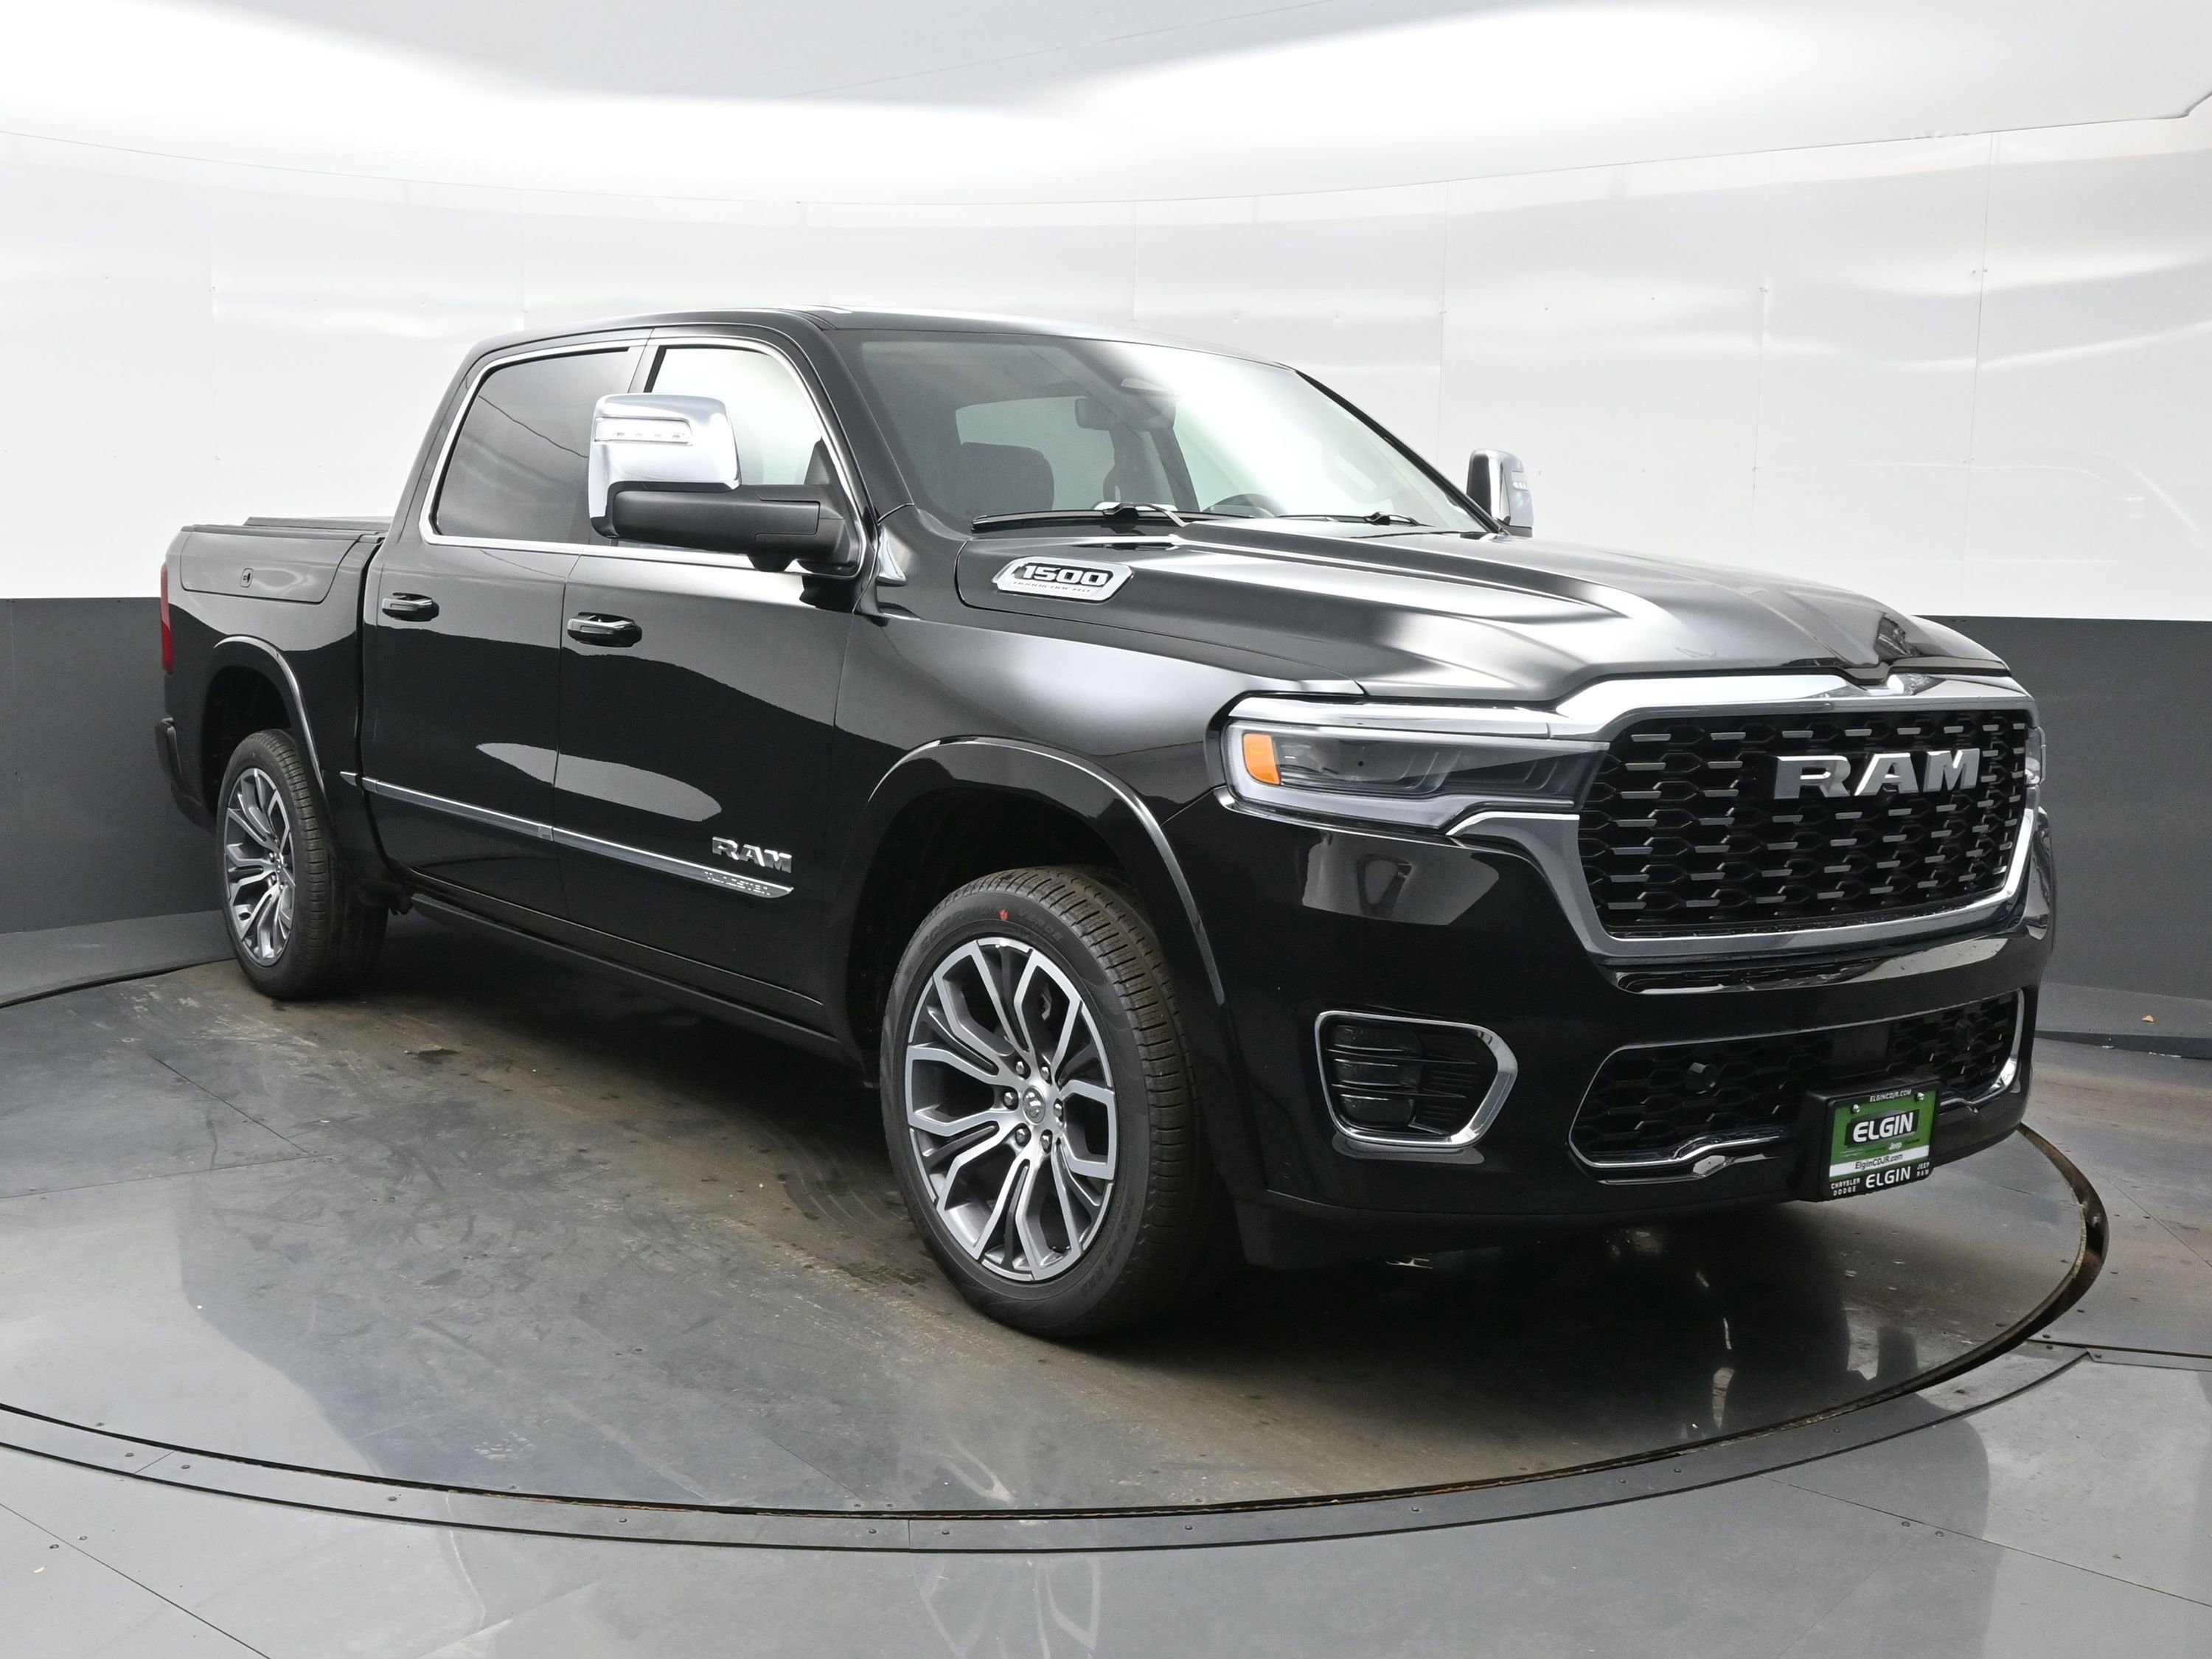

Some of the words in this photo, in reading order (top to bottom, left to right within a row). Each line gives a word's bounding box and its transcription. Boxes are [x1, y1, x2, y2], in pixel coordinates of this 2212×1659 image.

[1023, 565, 1109, 587] 1500
[1774, 748, 1981, 799] RAM
[712, 836, 792, 873] RAM
[1853, 1111, 1914, 1143] ELGIN
[1854, 1153, 1904, 1169] ElginCDJR.com
[1831, 1178, 1860, 1189] CHRYSLER
[1865, 1166, 1911, 1189] ELGIN
[1833, 1186, 1857, 1196] DODGE
